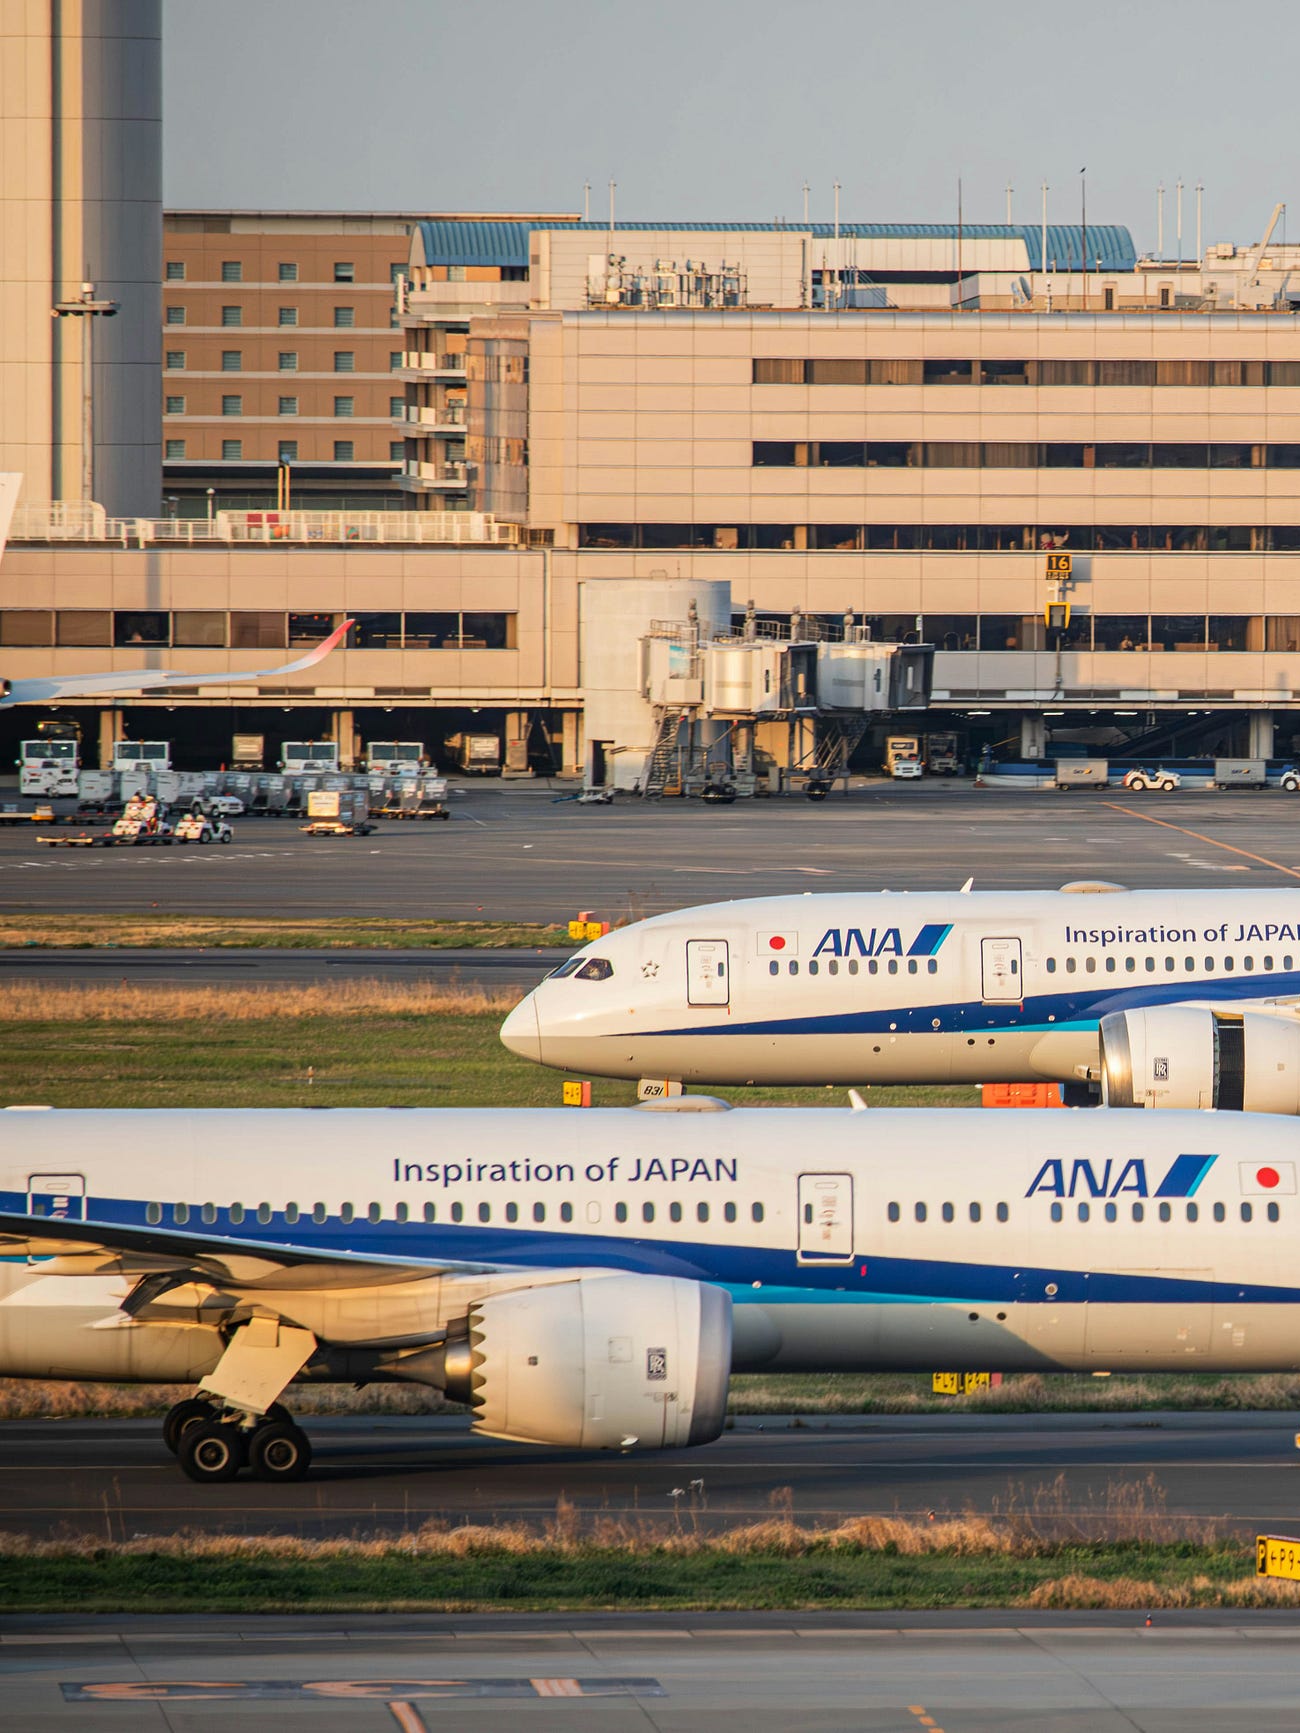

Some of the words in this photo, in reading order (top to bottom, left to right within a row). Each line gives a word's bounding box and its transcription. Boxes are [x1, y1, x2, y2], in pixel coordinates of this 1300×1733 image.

[1051, 556, 1069, 570] 16
[812, 927, 904, 957] ANA
[1065, 925, 1197, 947] Inspiration
[1203, 923, 1229, 943] of
[643, 1085, 665, 1097] 831
[393, 1157, 575, 1188] Inspiration
[585, 1156, 620, 1183] of
[627, 1157, 739, 1183] JAPAN
[1024, 1158, 1150, 1199] ANA
[1279, 1547, 1295, 1572] P9
